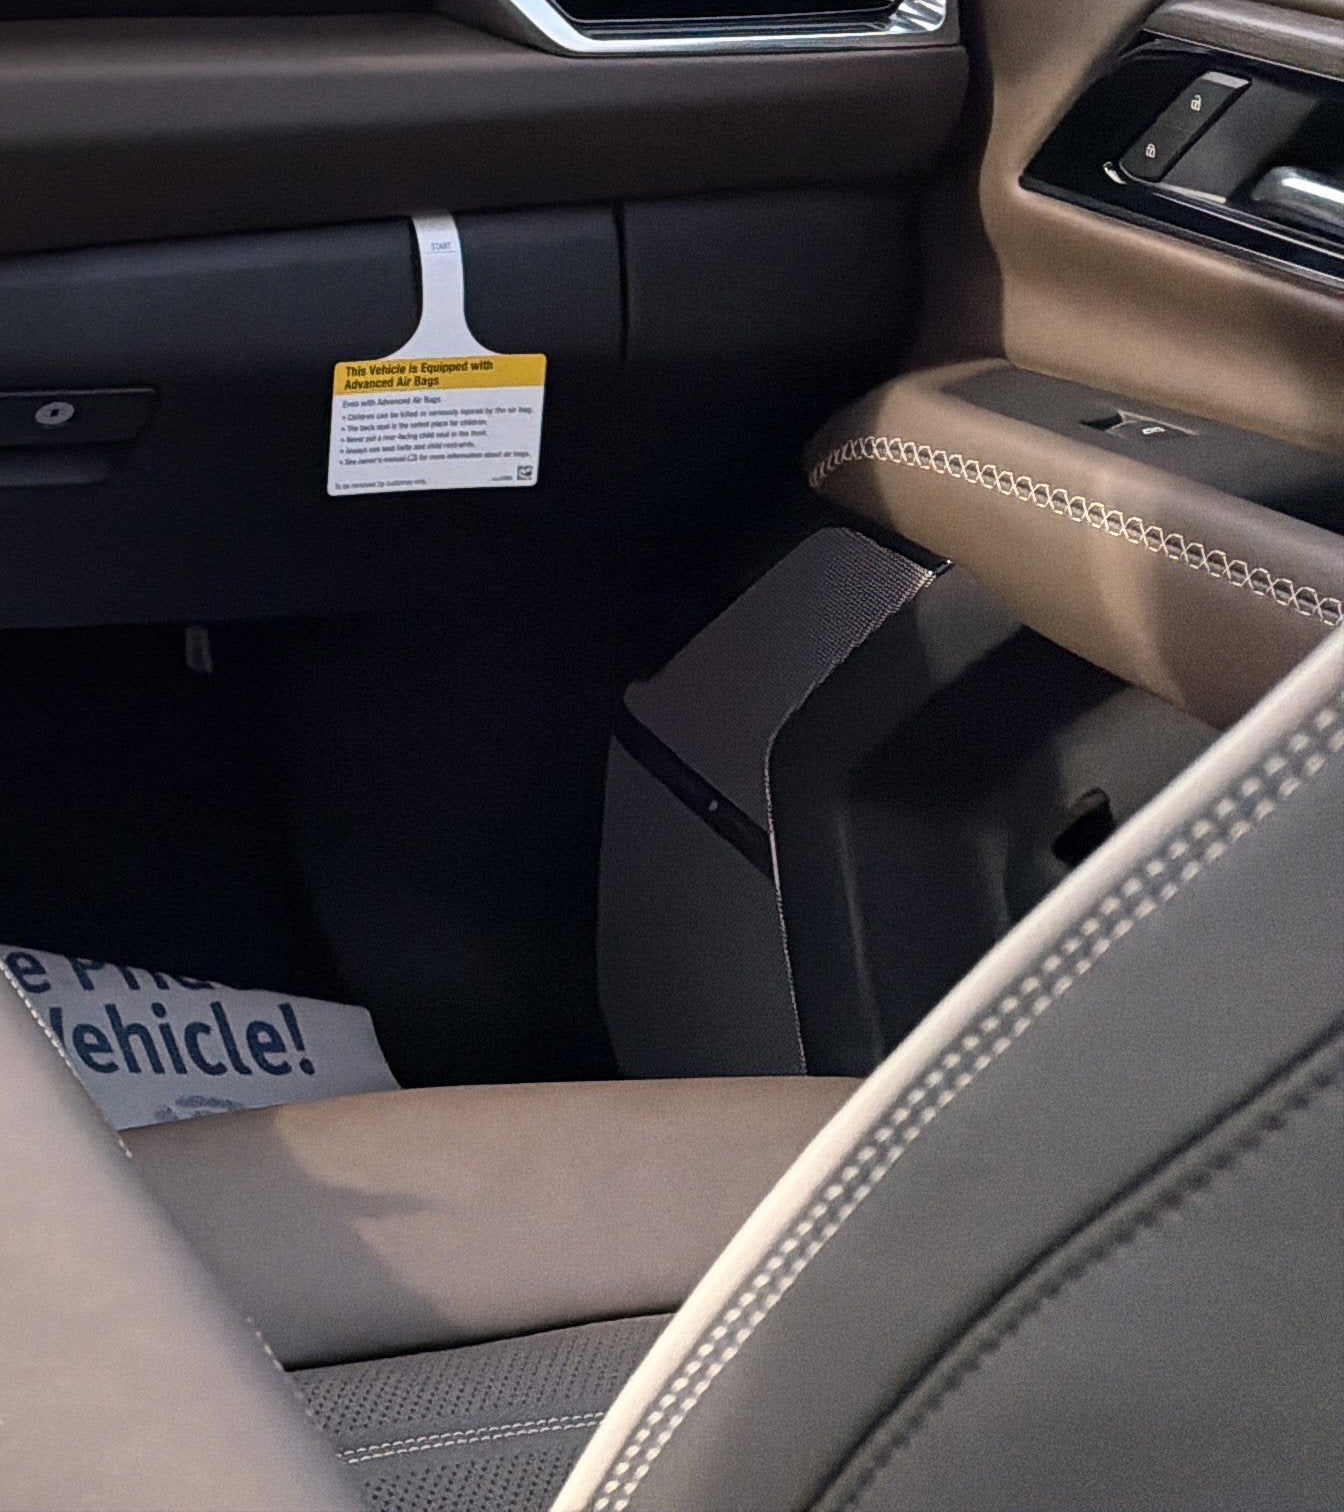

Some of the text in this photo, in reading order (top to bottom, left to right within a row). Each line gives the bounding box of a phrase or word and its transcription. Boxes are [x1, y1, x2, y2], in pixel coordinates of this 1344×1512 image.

[346, 365, 366, 376] This
[369, 363, 406, 375] Vehicle
[421, 361, 468, 375] Equipped
[471, 360, 493, 370] with
[344, 375, 439, 390] Advanced Air Bags
